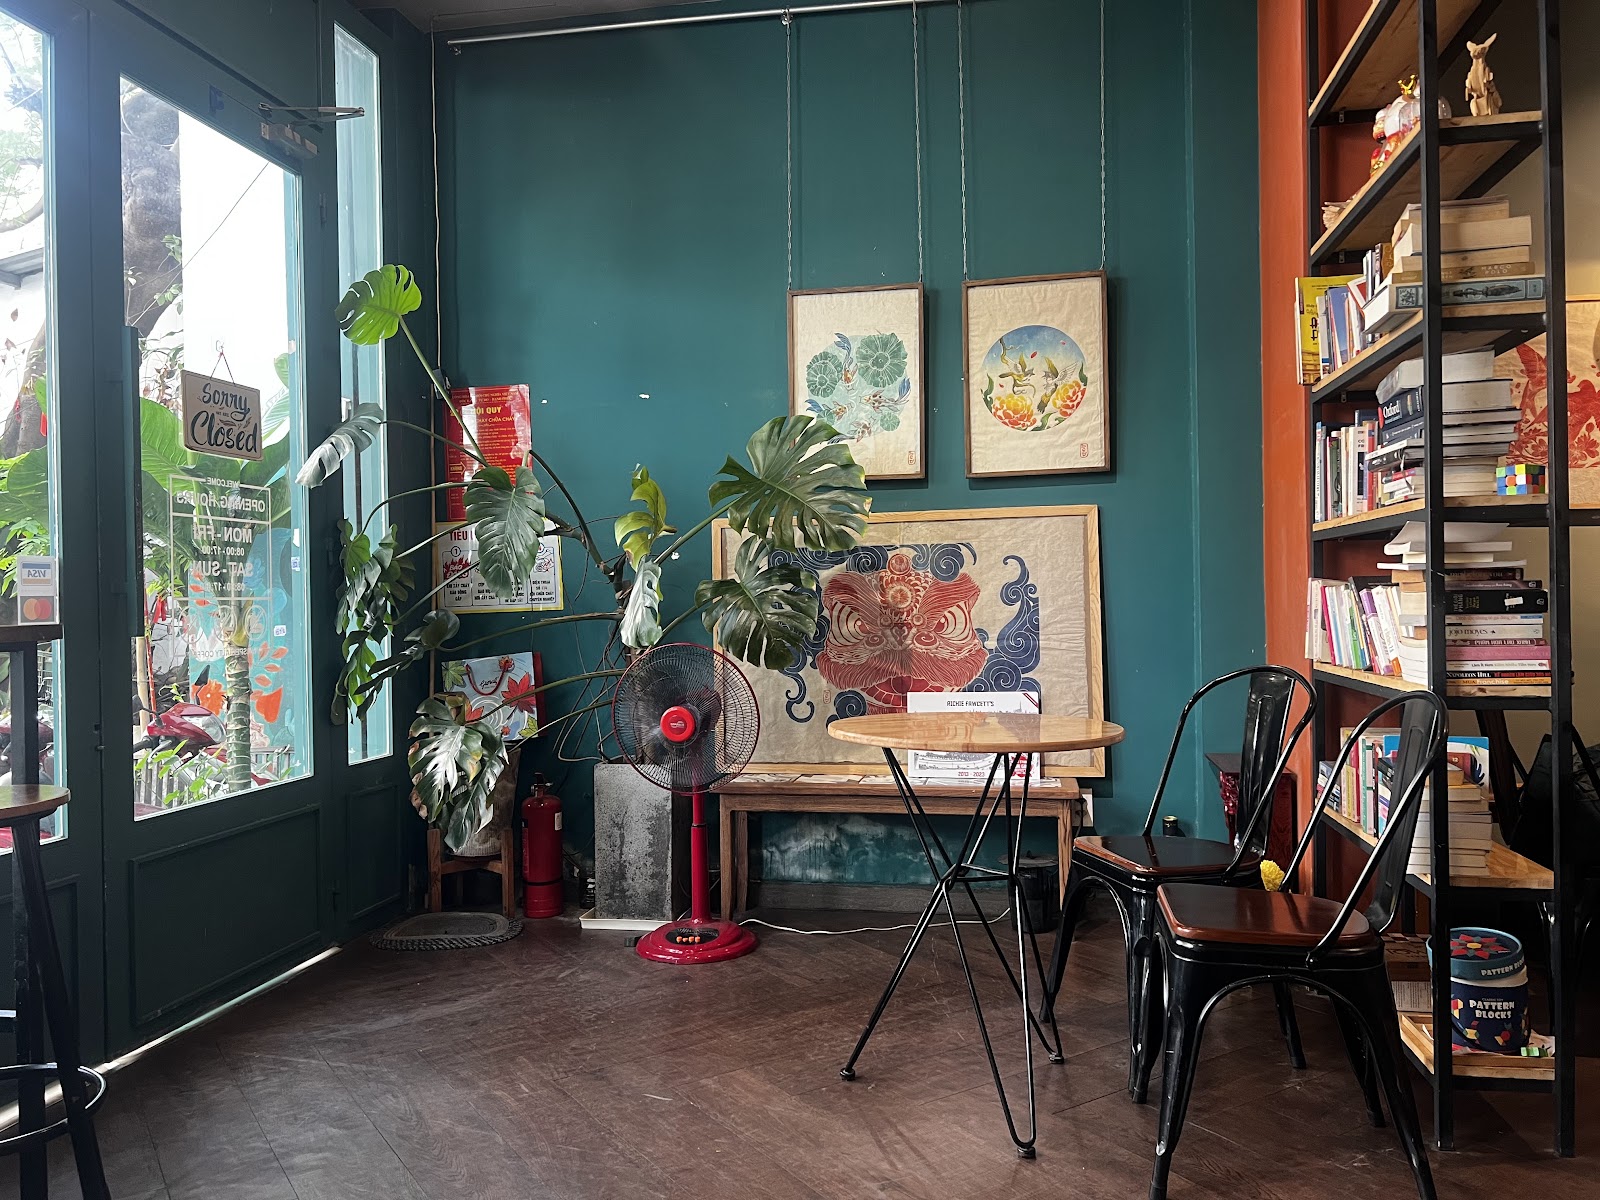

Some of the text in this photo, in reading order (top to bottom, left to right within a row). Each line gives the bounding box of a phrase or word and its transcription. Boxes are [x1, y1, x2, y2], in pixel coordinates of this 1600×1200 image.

[202, 382, 251, 422] Sorry
[1383, 400, 1400, 418] Oxford
[191, 410, 258, 453] Closed
[1464, 628, 1488, 637] moyes
[1480, 963, 1514, 976] PATTERN
[1469, 999, 1515, 1010] PATTERN
[1475, 1009, 1512, 1019] BLOCKS
